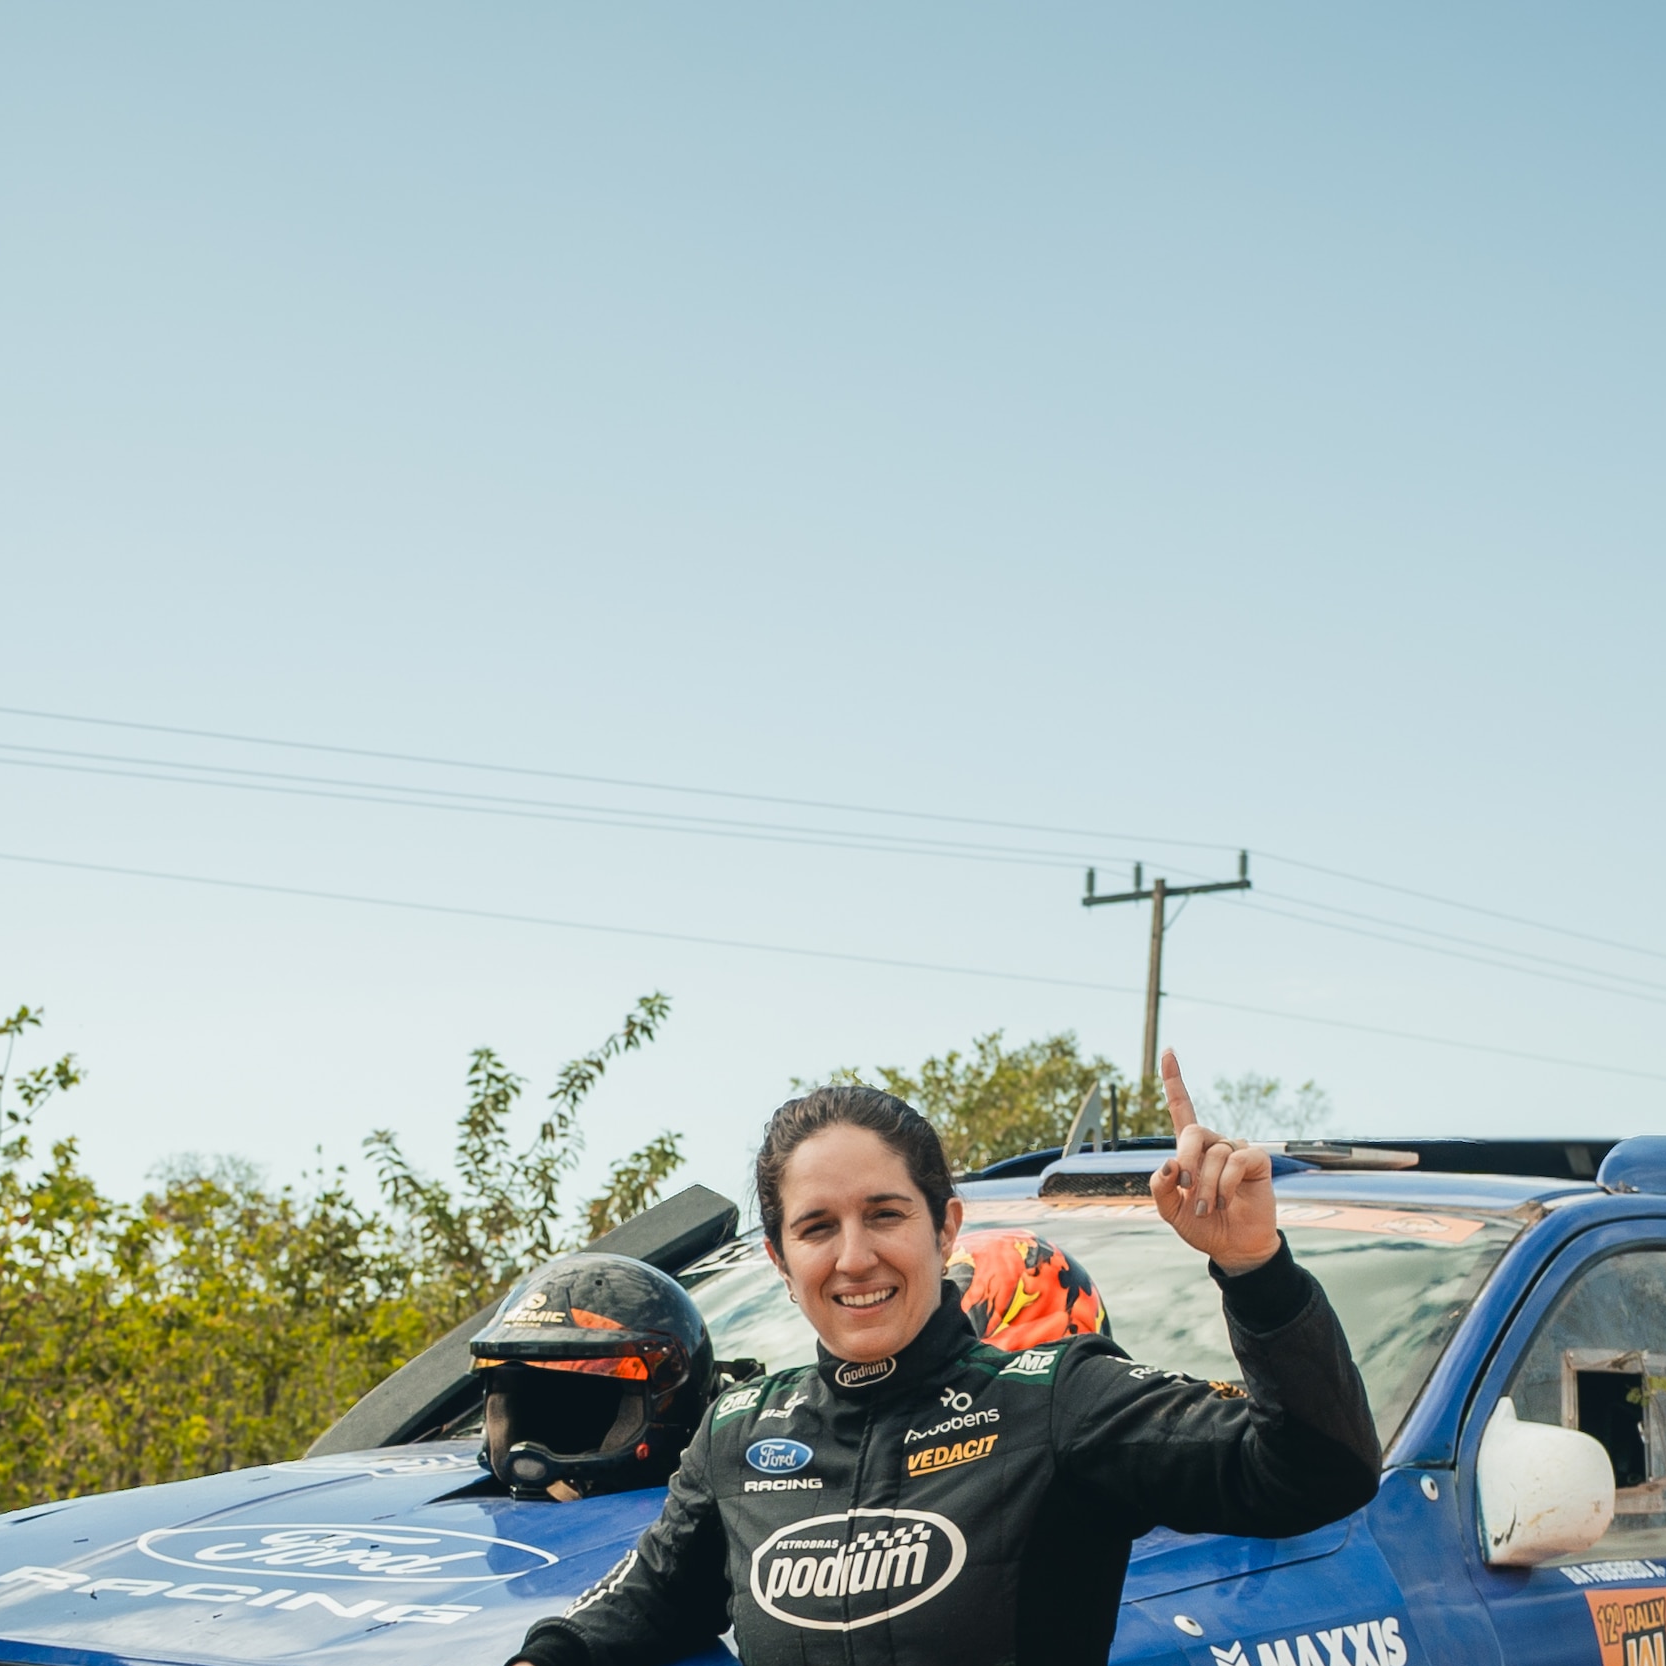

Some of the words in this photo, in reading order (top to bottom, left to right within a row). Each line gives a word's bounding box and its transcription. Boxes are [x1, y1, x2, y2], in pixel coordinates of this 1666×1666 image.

[843, 1361, 888, 1384] podium
[759, 1444, 797, 1468] Ford
[907, 1434, 999, 1473] VEDACIT
[744, 1478, 823, 1492] RACING
[194, 1529, 486, 1576] Ford
[776, 1540, 840, 1550] PETROBRAS
[765, 1542, 929, 1604] podium
[1624, 1596, 1666, 1633] RALLY
